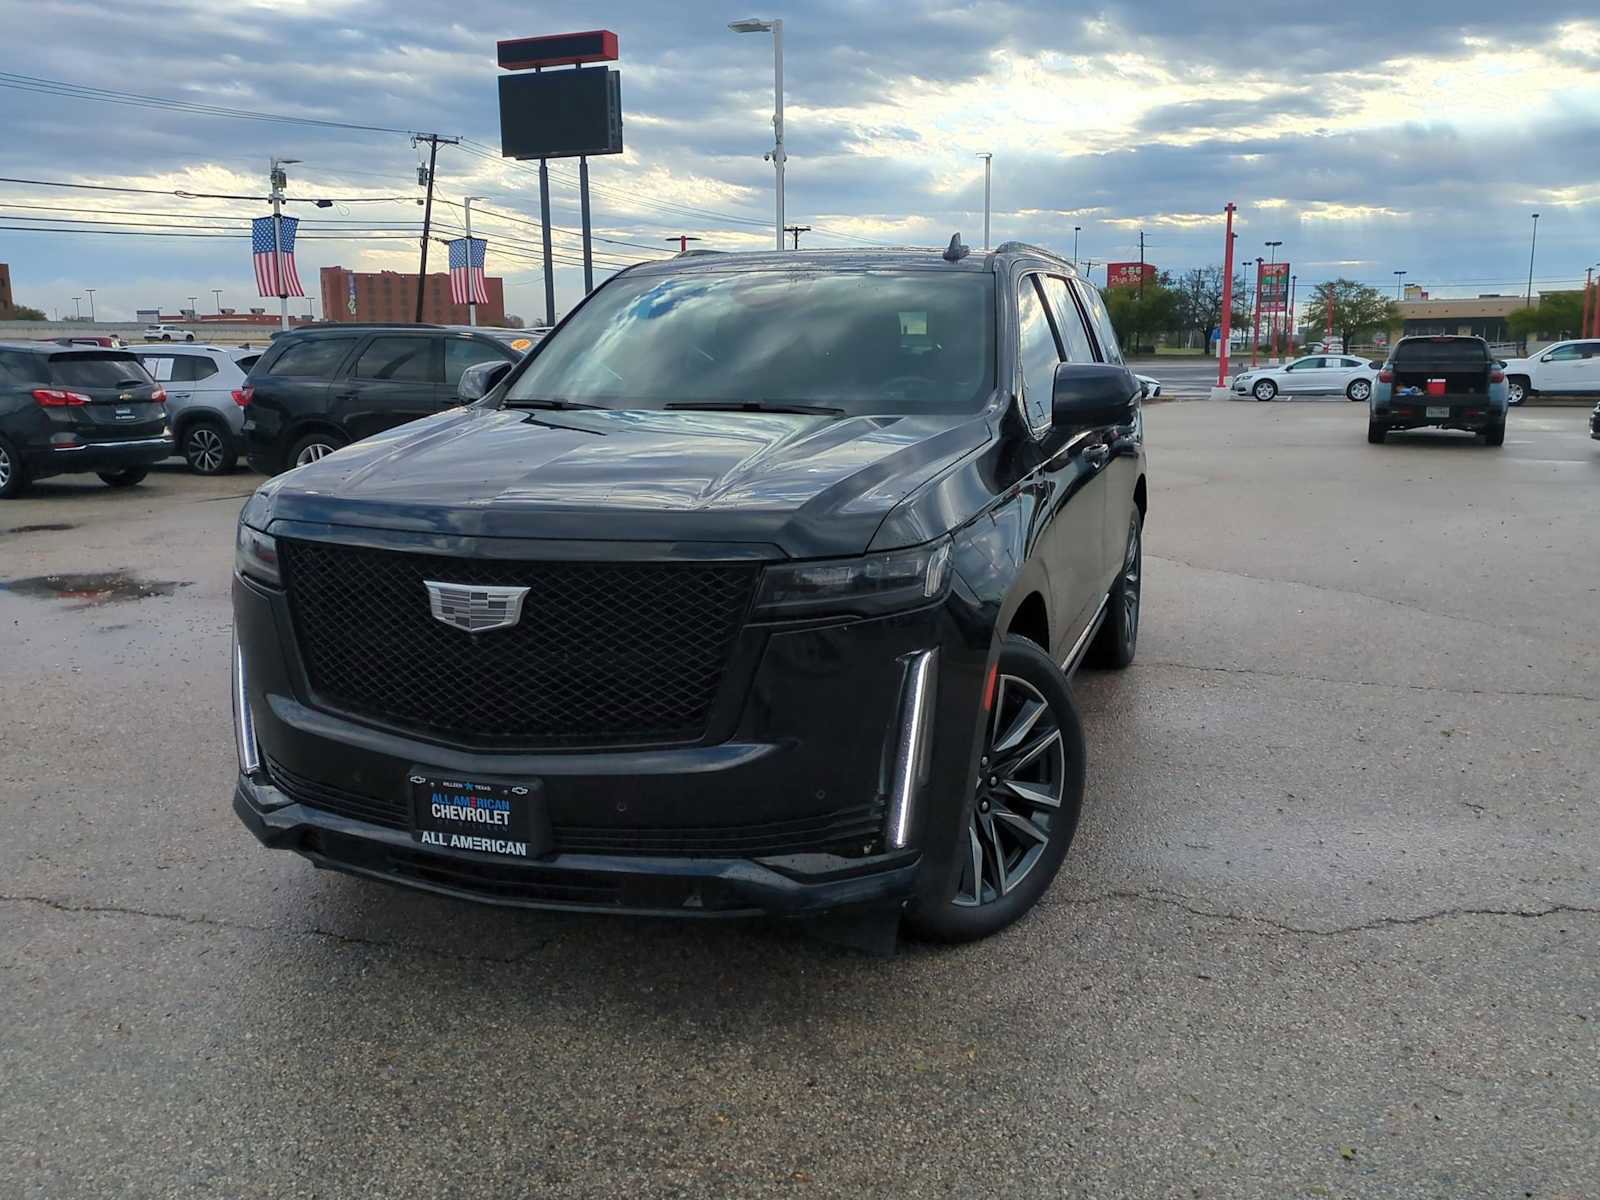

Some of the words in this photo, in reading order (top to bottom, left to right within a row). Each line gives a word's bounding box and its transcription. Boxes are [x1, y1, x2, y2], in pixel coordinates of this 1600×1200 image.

[432, 793, 449, 804] ALL
[453, 794, 510, 811] AMERICAN
[431, 804, 510, 825] CHEVROLET
[421, 831, 448, 846] ALL
[450, 834, 527, 856] AMERICAN
